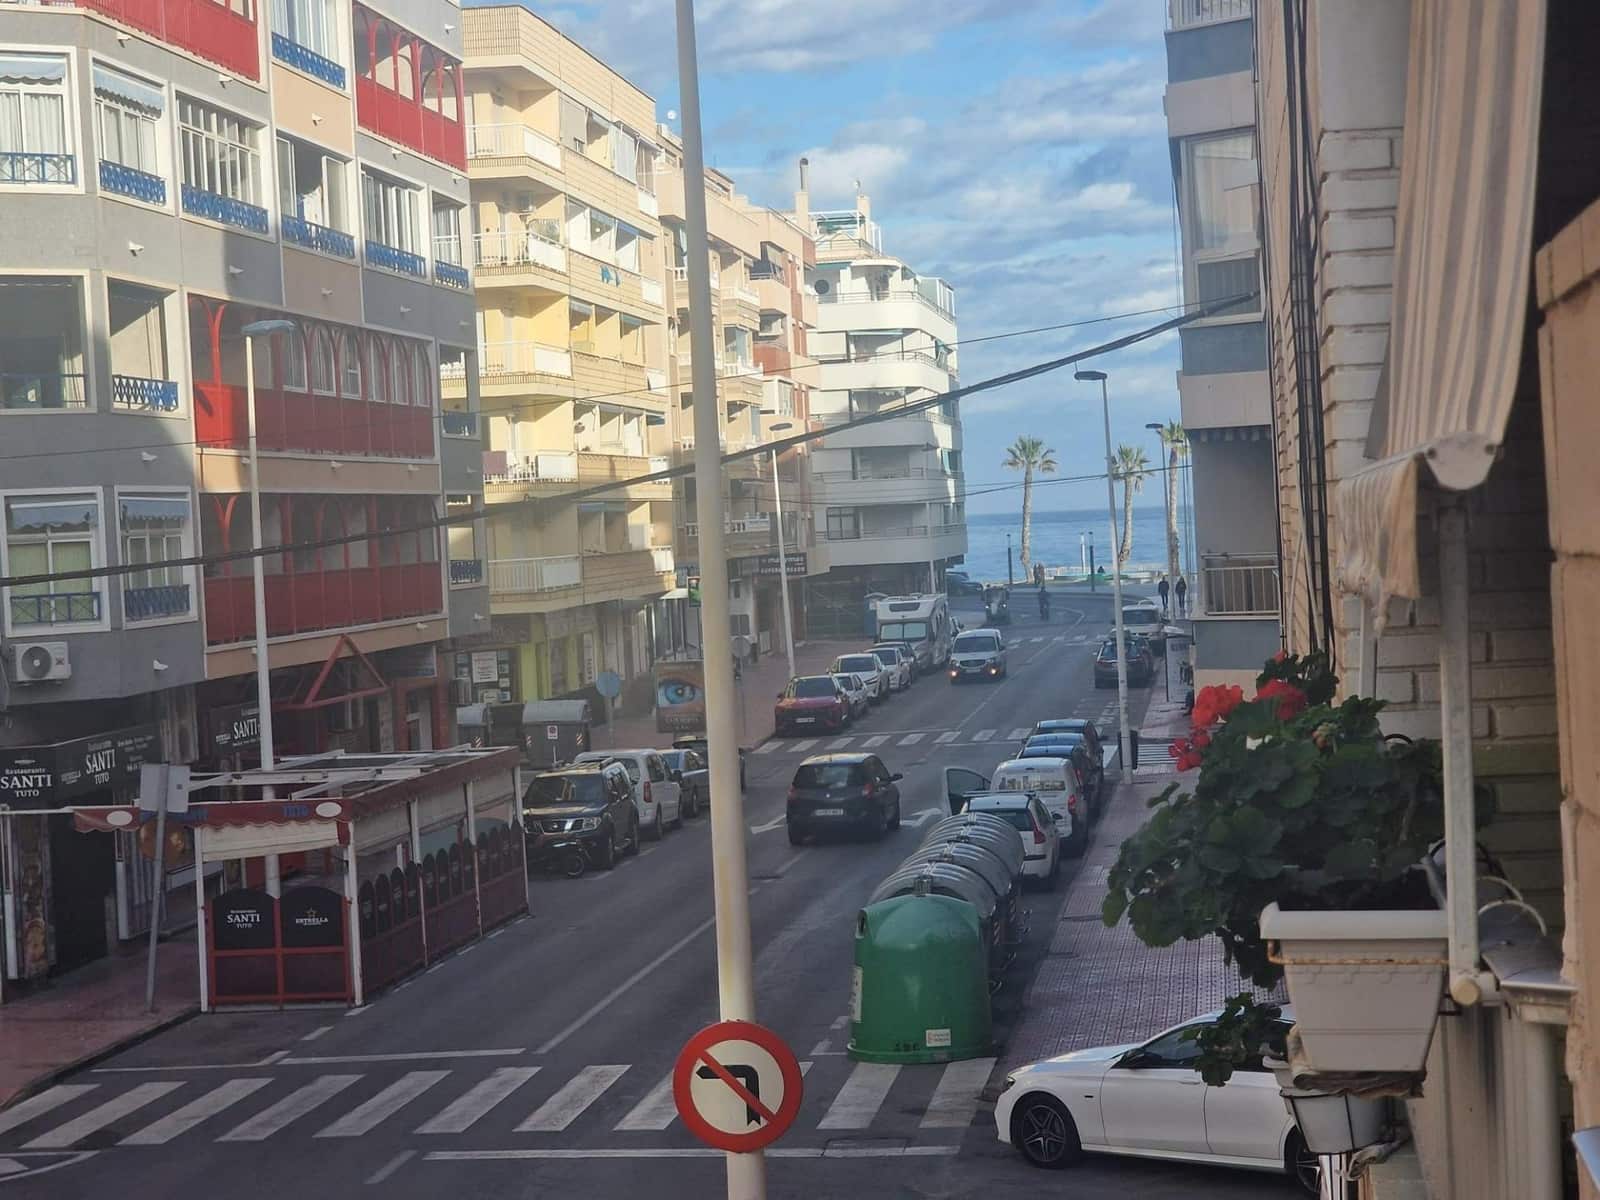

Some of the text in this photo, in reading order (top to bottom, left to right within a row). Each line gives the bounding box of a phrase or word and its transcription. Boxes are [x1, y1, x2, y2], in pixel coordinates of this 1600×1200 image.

[233, 718, 257, 740] SANTI
[85, 749, 116, 774] SANTI
[0, 774, 52, 789] SANTI
[94, 772, 110, 784] TUTO
[15, 789, 40, 798] TUTO
[227, 913, 261, 924] SANTI
